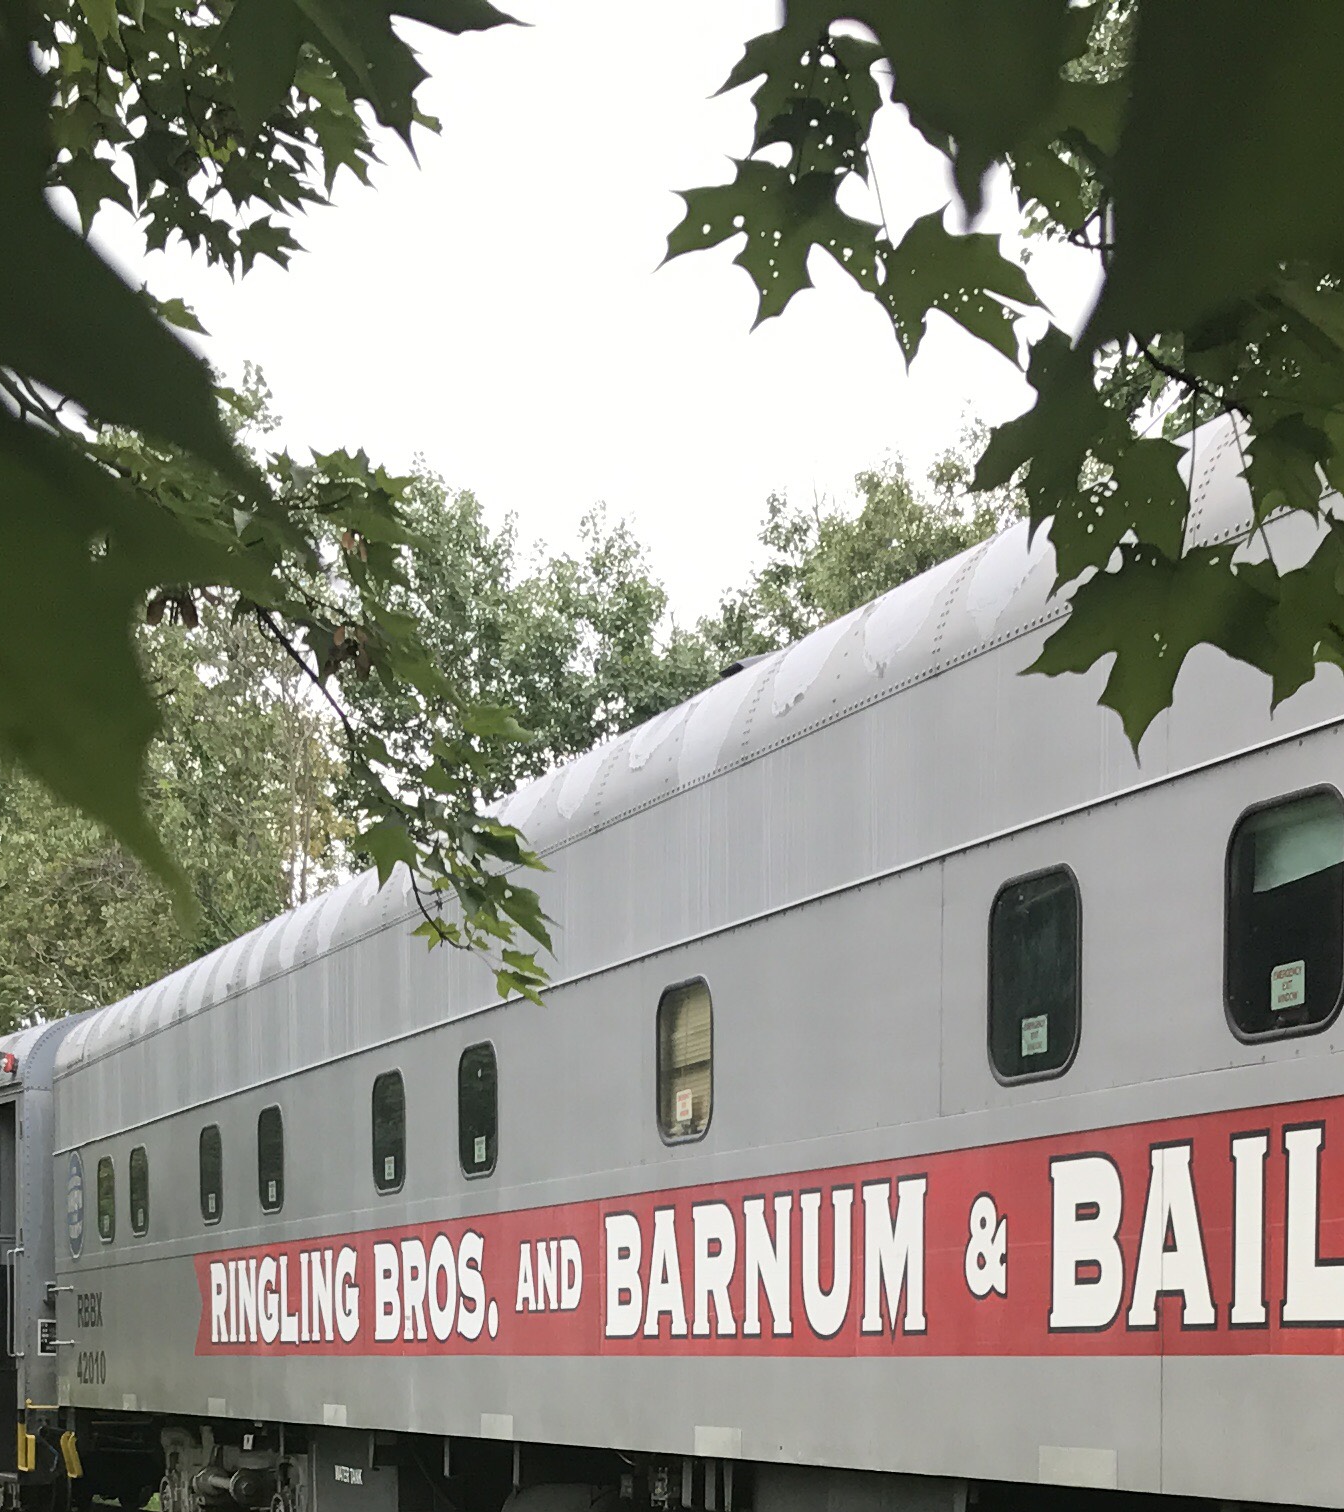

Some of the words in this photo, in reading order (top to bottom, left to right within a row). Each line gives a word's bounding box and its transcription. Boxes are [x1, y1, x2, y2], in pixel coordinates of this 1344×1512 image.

[210, 1246, 360, 1344] RINGLING
[373, 1230, 499, 1341] BROS.
[515, 1236, 583, 1313] AND
[605, 1172, 928, 1342] BARNUM
[964, 1191, 1007, 1299] &
[77, 1292, 104, 1328] RBBX
[77, 1350, 107, 1385] 42010
